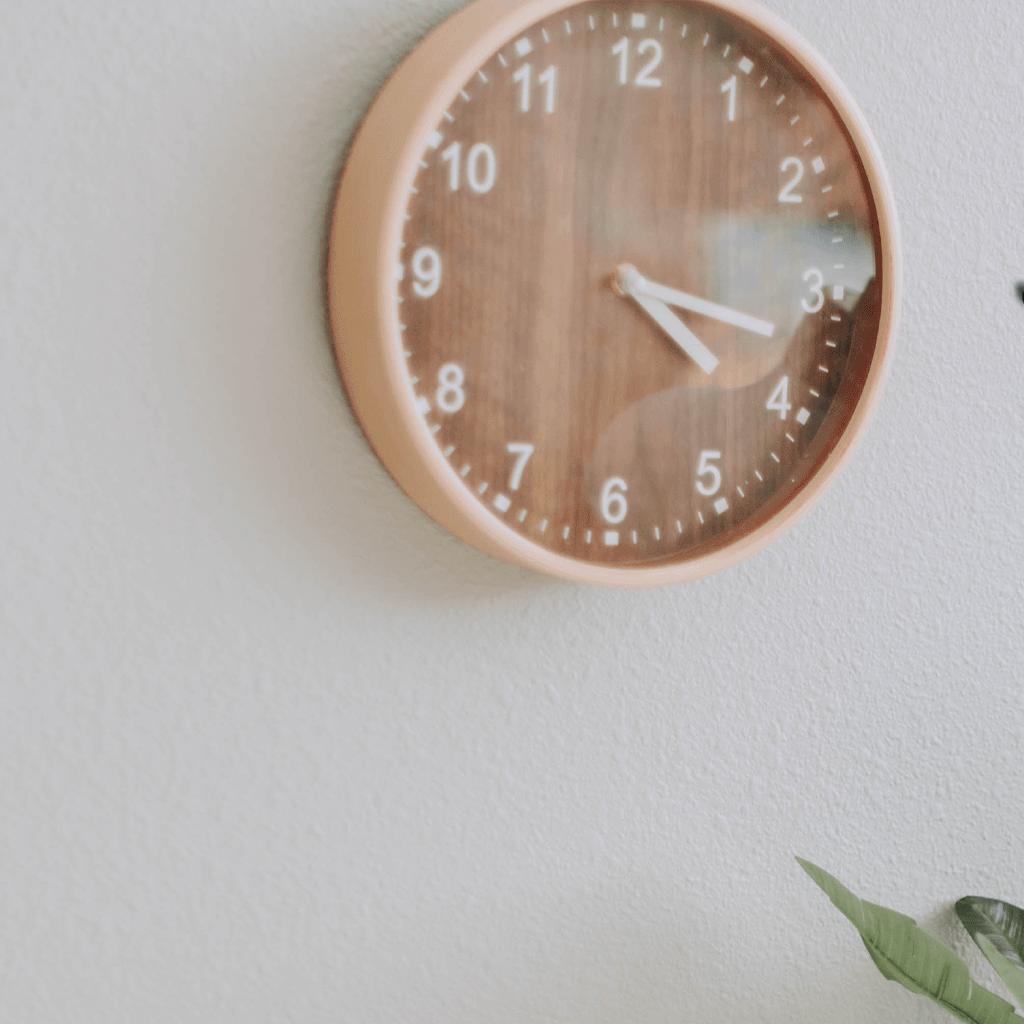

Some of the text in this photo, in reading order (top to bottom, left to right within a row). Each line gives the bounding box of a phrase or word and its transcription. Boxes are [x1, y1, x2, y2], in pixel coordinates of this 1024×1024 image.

[611, 37, 662, 88] 12
[513, 63, 557, 114] 11
[720, 76, 739, 121] 1
[442, 142, 497, 194] 10
[778, 156, 803, 203] 2
[411, 247, 443, 298] 9
[801, 267, 825, 314] 3
[435, 363, 466, 413] 8
[766, 376, 791, 420] 4
[507, 442, 534, 490] 7
[696, 450, 721, 496] 5
[600, 477, 628, 523] 6
